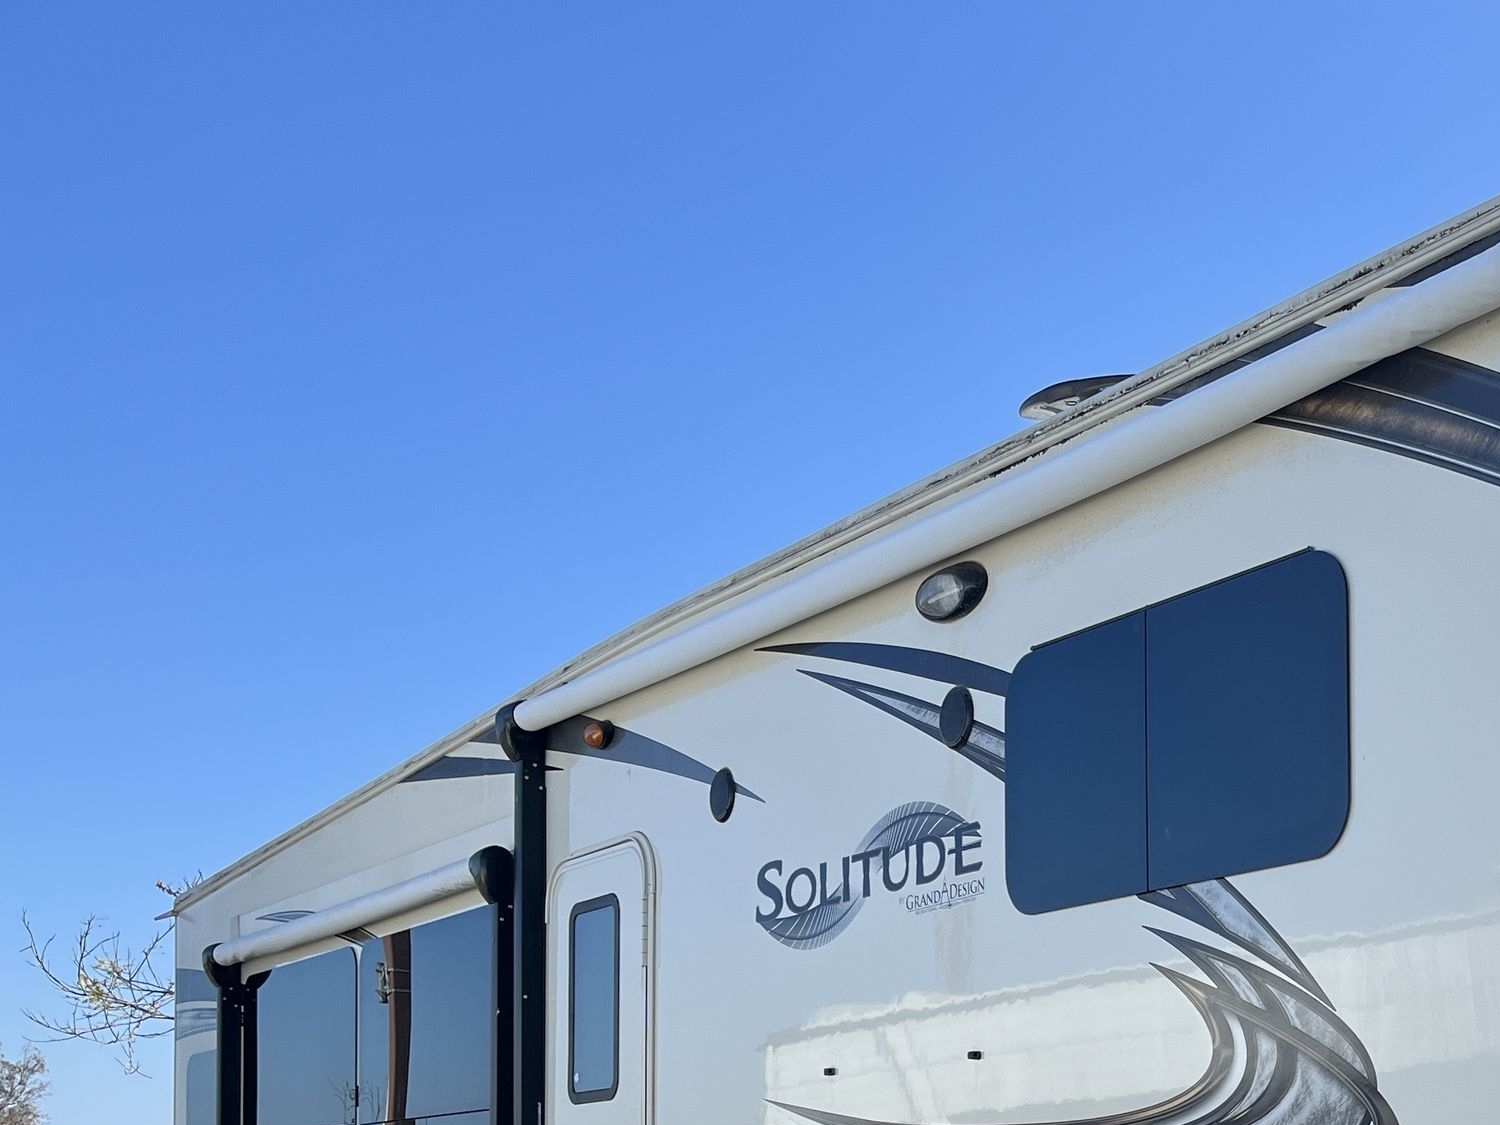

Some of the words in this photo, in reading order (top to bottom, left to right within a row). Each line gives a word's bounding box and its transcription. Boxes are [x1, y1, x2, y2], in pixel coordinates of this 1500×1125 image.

[756, 821, 983, 923] SOLITUDE
[905, 890, 941, 911] GRAND
[949, 878, 985, 900] DESIGN
